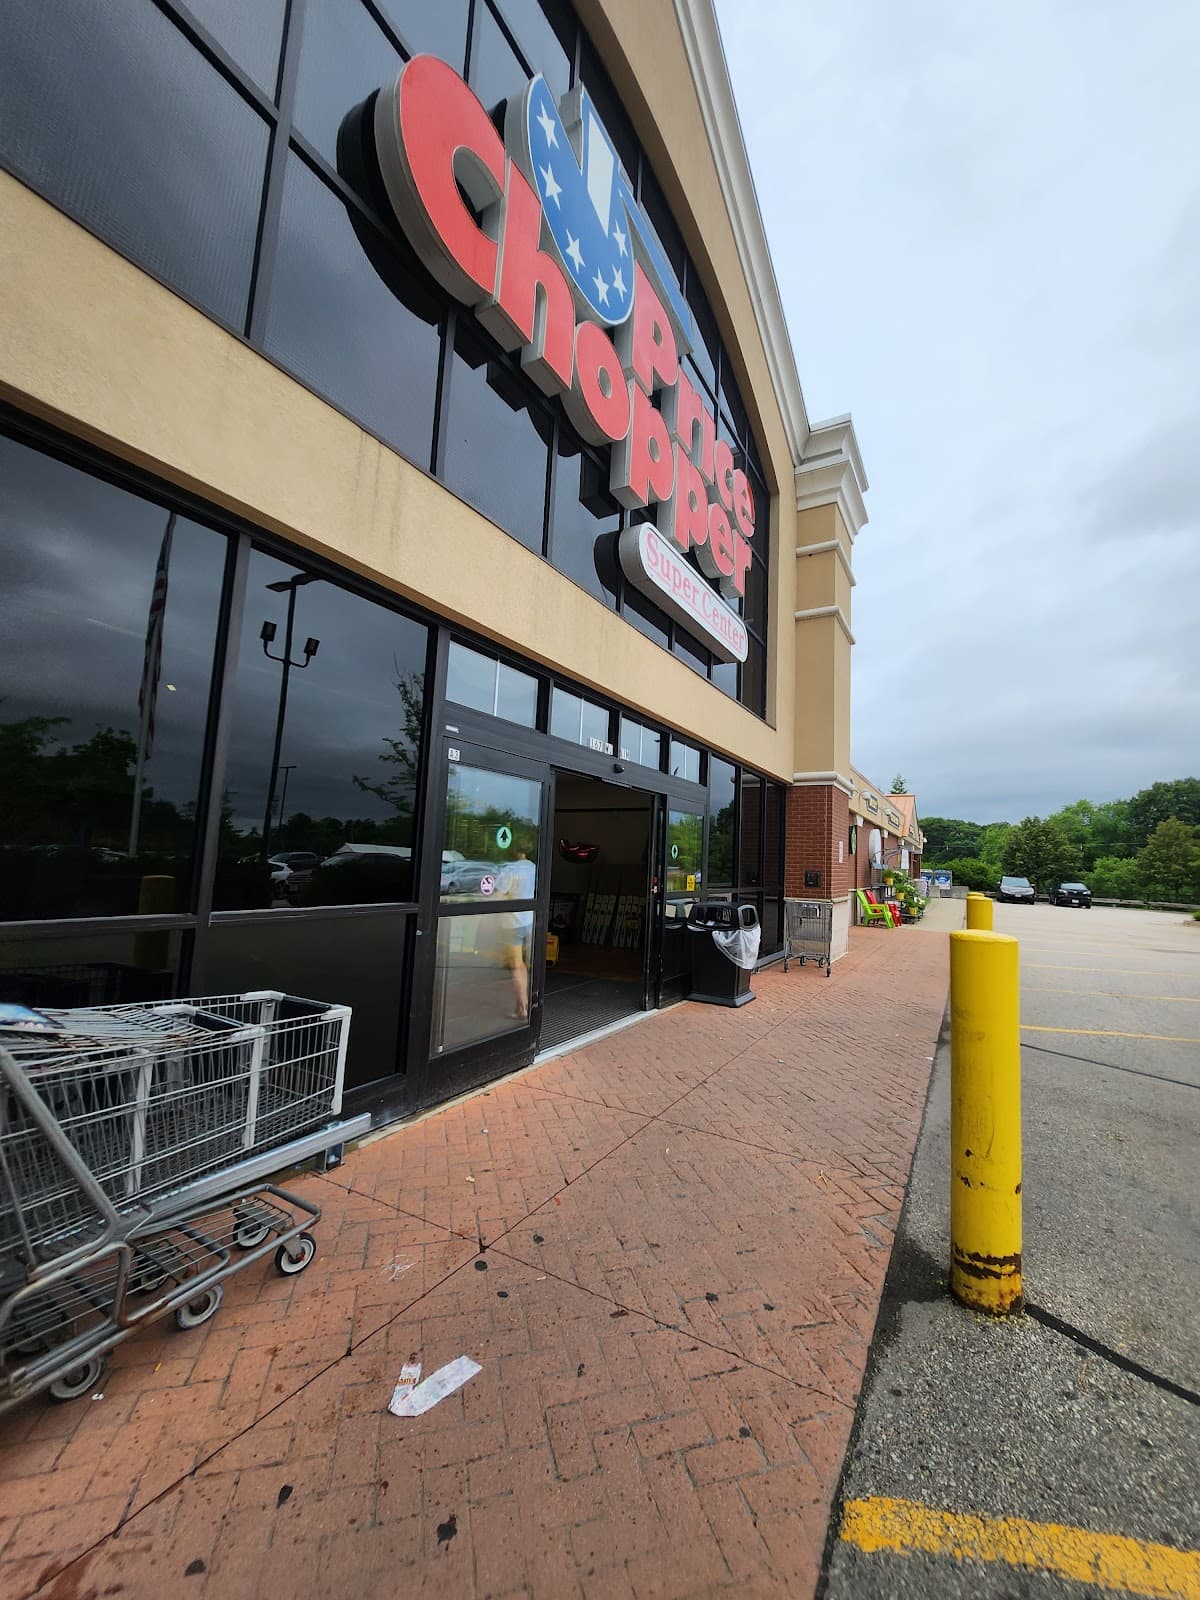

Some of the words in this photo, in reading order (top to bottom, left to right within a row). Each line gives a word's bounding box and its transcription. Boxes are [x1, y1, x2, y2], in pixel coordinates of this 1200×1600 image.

[399, 53, 753, 597] Chopper
[645, 531, 700, 606] Super
[702, 590, 745, 650] Center
